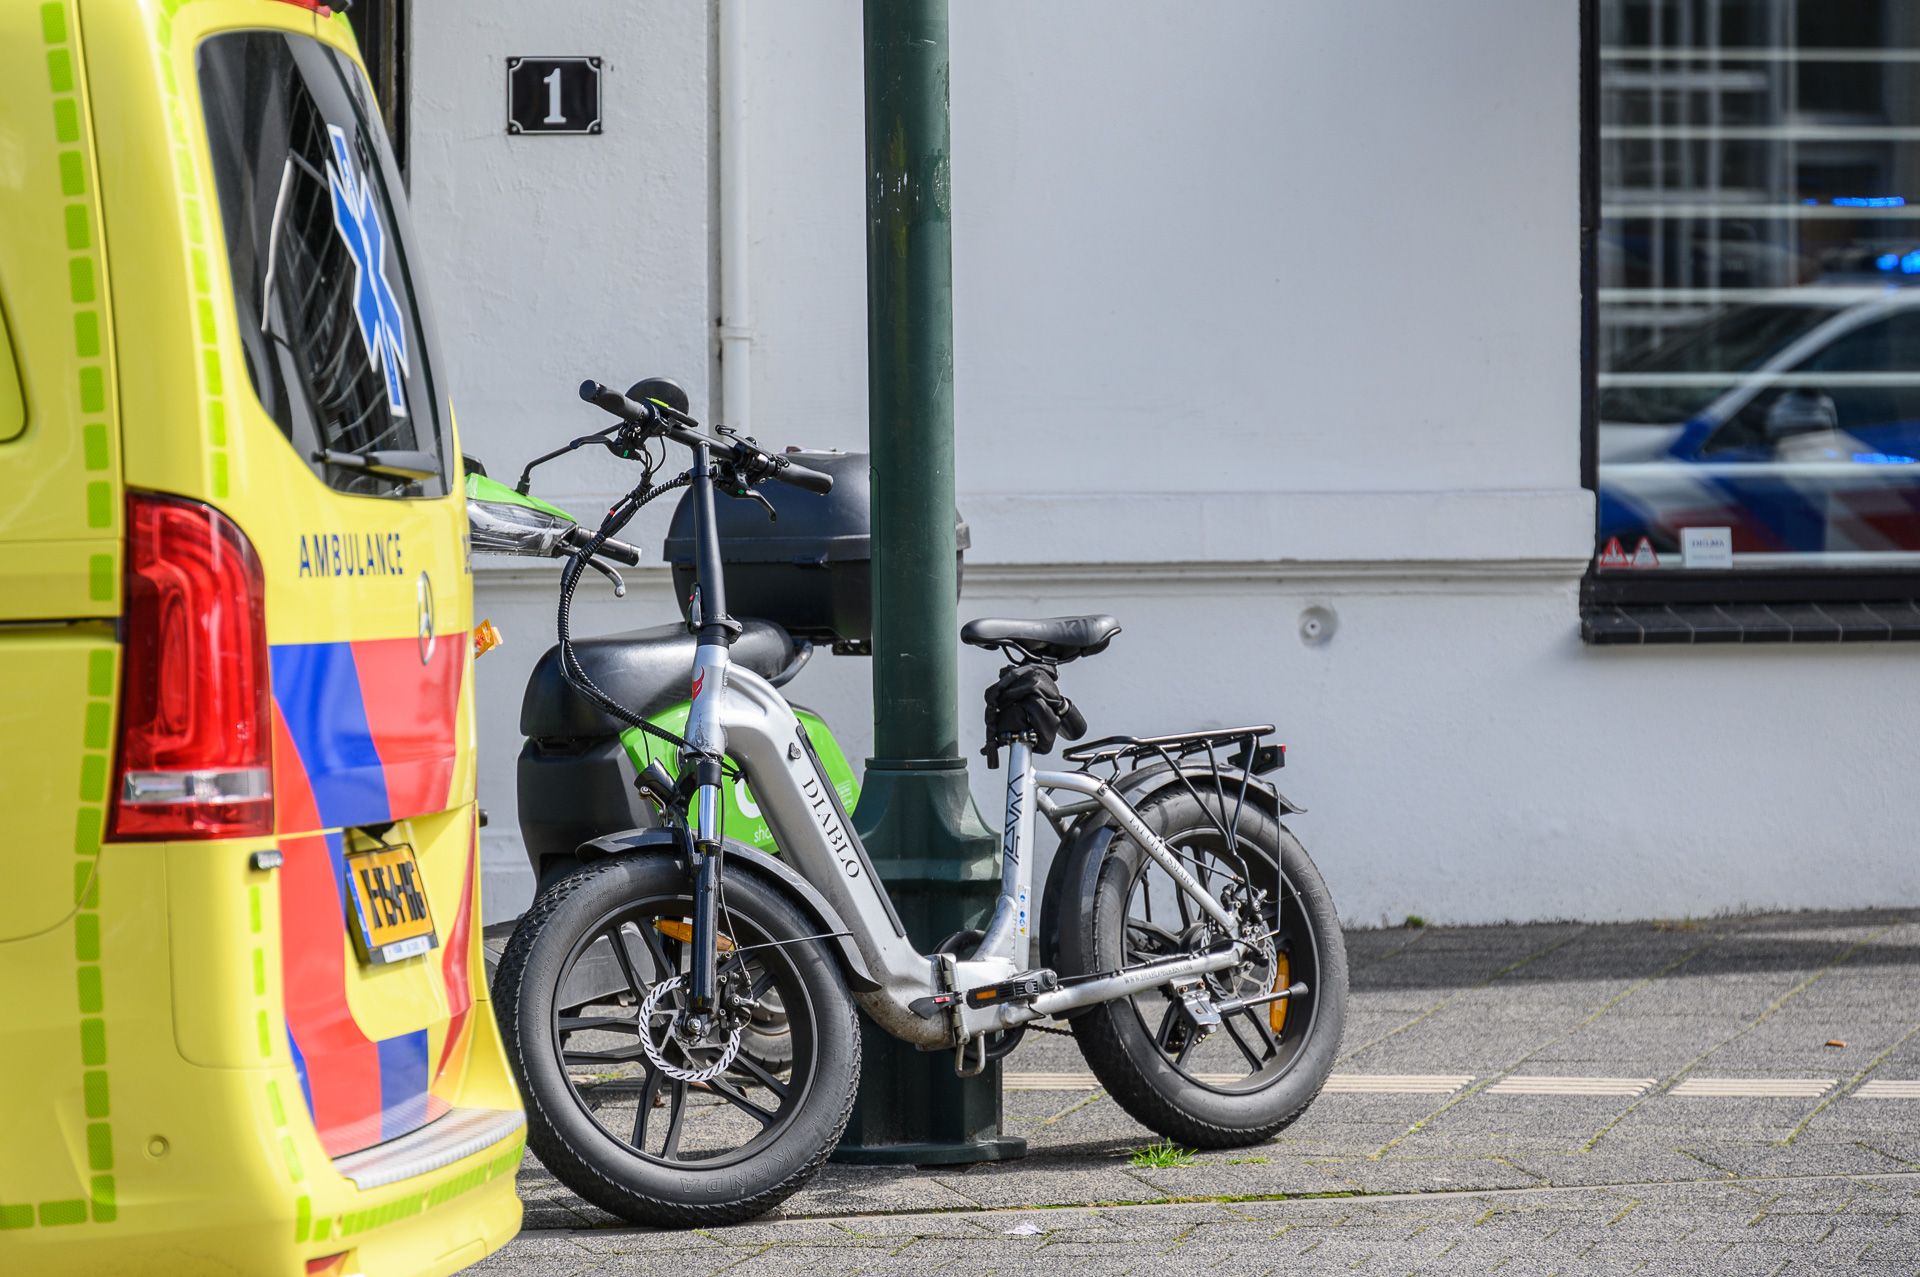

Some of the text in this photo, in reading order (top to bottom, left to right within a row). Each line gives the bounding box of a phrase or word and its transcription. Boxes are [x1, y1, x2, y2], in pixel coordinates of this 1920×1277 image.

[543, 67, 567, 124] 1
[299, 533, 403, 578] AMBULANCE
[801, 777, 860, 879] DIABLO
[1128, 817, 1196, 888] FAT CITY SMART
[680, 1146, 794, 1194] KENDA
